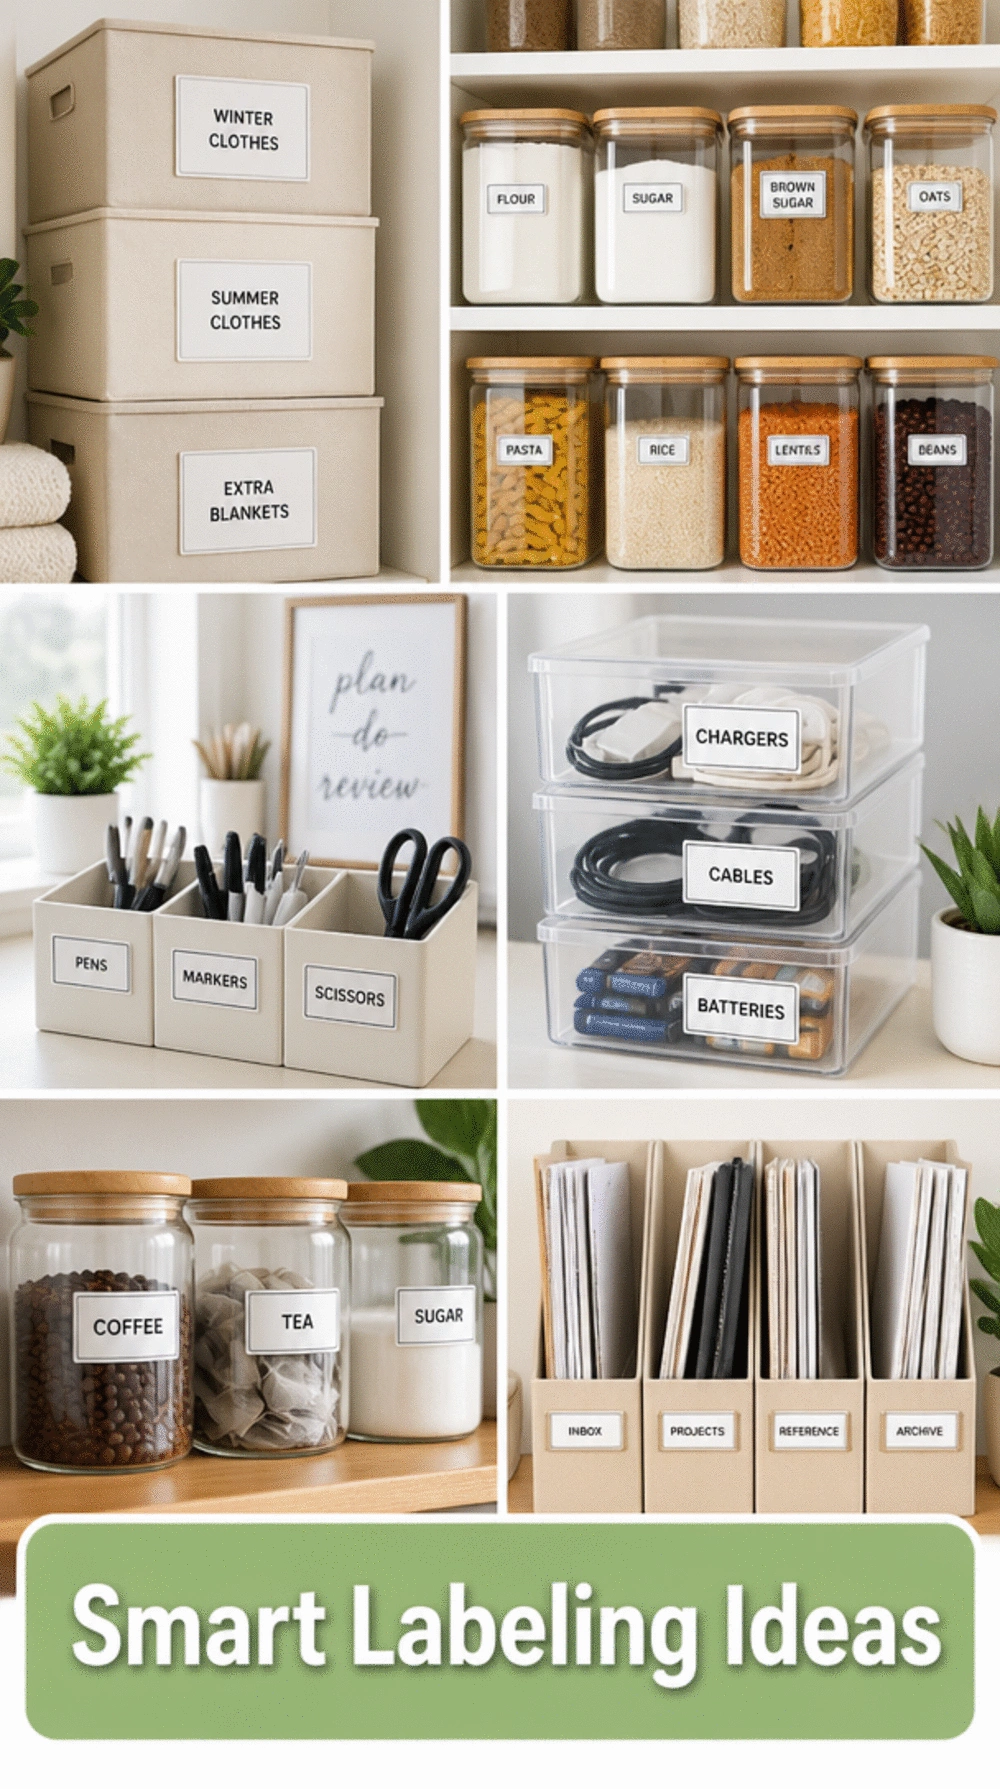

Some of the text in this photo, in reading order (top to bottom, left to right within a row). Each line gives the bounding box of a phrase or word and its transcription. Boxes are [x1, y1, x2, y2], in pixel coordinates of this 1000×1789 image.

[213, 108, 273, 126] WINTER
[208, 132, 279, 151] CLOTHES
[770, 181, 816, 193] BROWN
[497, 193, 536, 205] FLOUR
[632, 192, 674, 204] SUGAR
[772, 196, 814, 209] SUGAR
[918, 190, 952, 203] OATS
[211, 290, 279, 306] SUMMER
[210, 314, 281, 330] CLOTHES
[506, 444, 543, 456] PASTA
[649, 443, 675, 456] RICE
[918, 443, 957, 456] BEANS
[224, 479, 274, 496] EXTRA
[210, 503, 289, 522] BLANKETS
[328, 648, 418, 715] plan
[351, 707, 390, 753] do
[695, 728, 789, 748] CHARGERS
[317, 767, 421, 802] review
[708, 866, 774, 886] CABLES
[75, 956, 108, 972] PENS
[183, 969, 248, 990] MARKERS
[315, 985, 385, 1008] SCISSORS
[697, 997, 785, 1021] BATTERIES
[281, 1313, 314, 1330] TEA
[414, 1307, 463, 1325] SUGAR
[92, 1317, 163, 1336] COFFEE
[568, 1426, 603, 1437] INBOX
[670, 1426, 726, 1437] PROJECTS
[779, 1426, 839, 1437] REFERENCE
[896, 1426, 943, 1437] ARCHIVE
